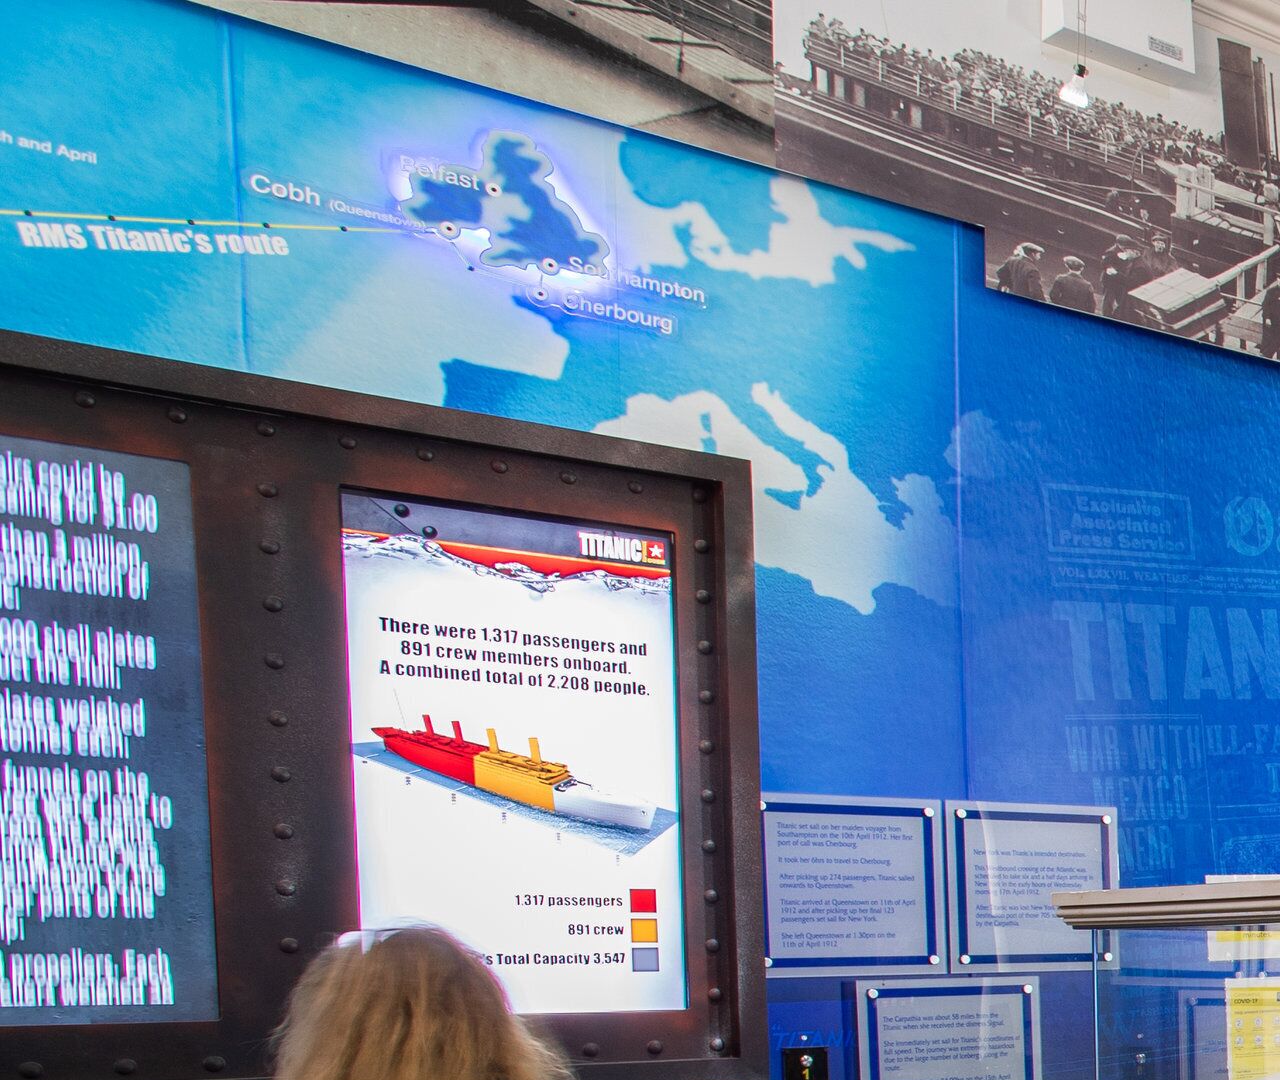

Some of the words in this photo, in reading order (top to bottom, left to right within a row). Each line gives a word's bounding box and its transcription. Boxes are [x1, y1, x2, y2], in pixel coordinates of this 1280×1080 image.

[17, 135, 52, 154] and
[56, 145, 98, 166] April
[250, 173, 321, 208] Cobh
[20, 221, 86, 249] RMS
[92, 225, 214, 253] Titanic's
[219, 231, 290, 256] route
[564, 292, 673, 335] Cherbourg
[580, 531, 643, 562] TITANIC
[379, 617, 430, 636] There
[435, 625, 476, 641] were
[523, 632, 615, 653] passengers
[620, 642, 647, 656] and
[401, 641, 430, 656] 891
[436, 645, 476, 660] crew
[482, 649, 558, 668] members
[563, 656, 631, 674] onboard.
[380, 660, 390, 674] A
[396, 662, 481, 682] combined
[486, 670, 522, 686] total
[528, 672, 543, 686] of
[594, 680, 650, 697] people.
[548, 895, 622, 907] passengers
[568, 924, 590, 935] 891
[593, 925, 624, 935] crew
[496, 953, 529, 964] Total
[534, 953, 590, 965] Capacity
[803, 1069, 810, 1080] 1
